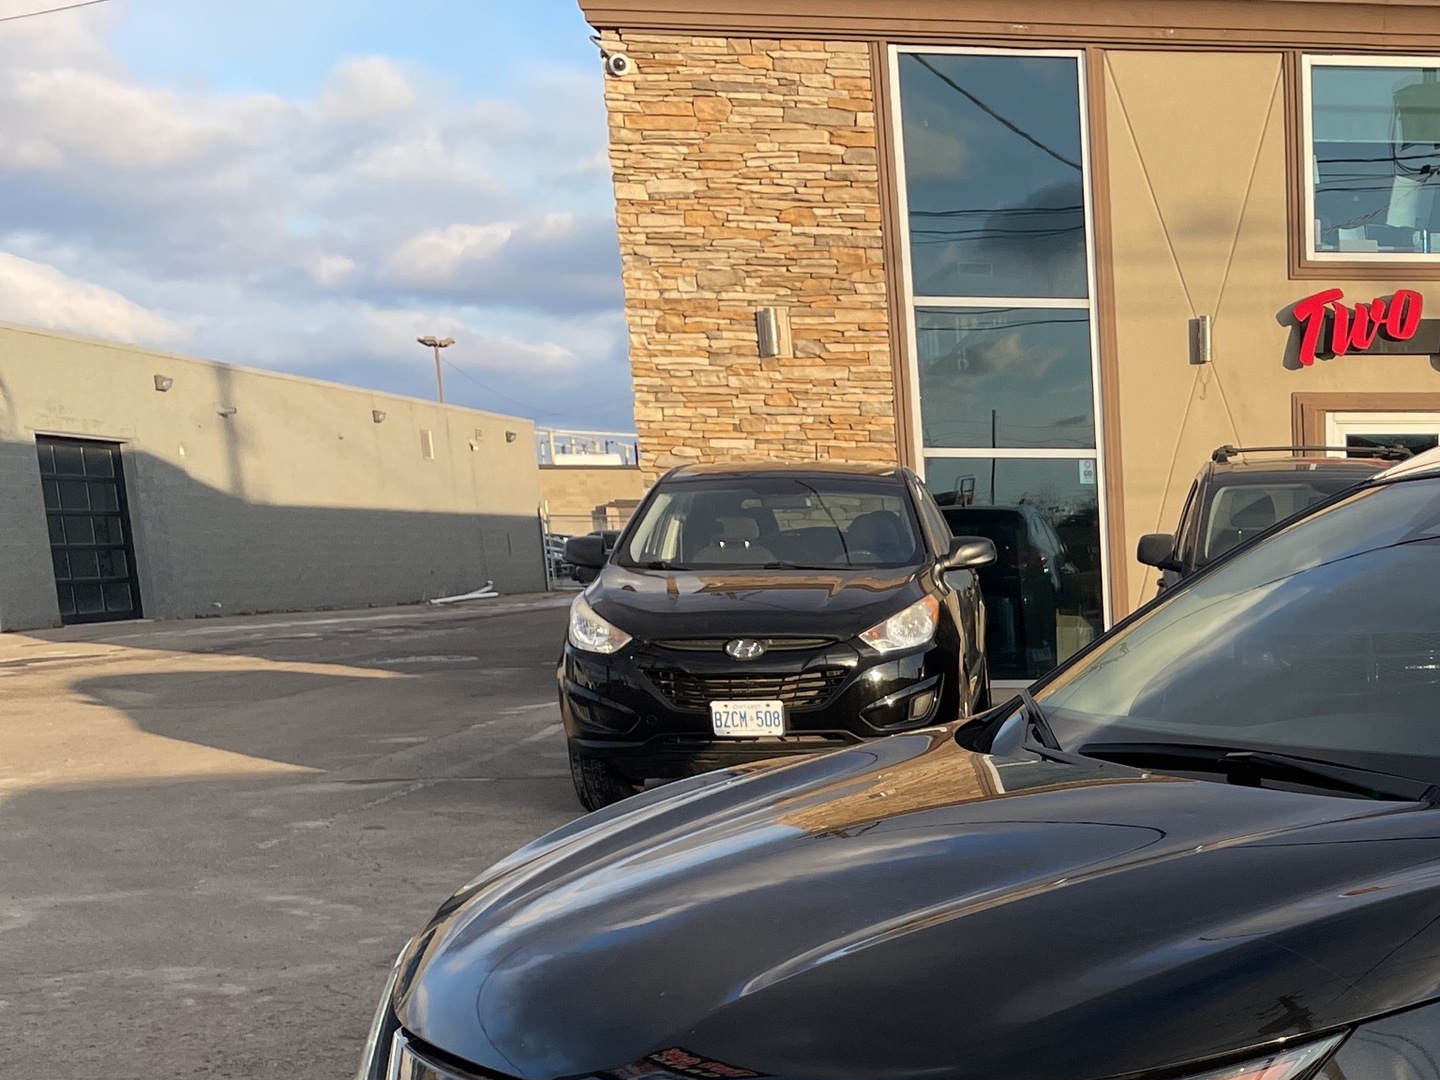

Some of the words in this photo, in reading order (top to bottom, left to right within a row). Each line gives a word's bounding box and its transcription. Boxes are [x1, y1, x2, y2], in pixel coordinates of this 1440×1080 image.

[1294, 288, 1423, 366] Two
[714, 711, 748, 728] BZCM
[755, 710, 781, 728] 508
